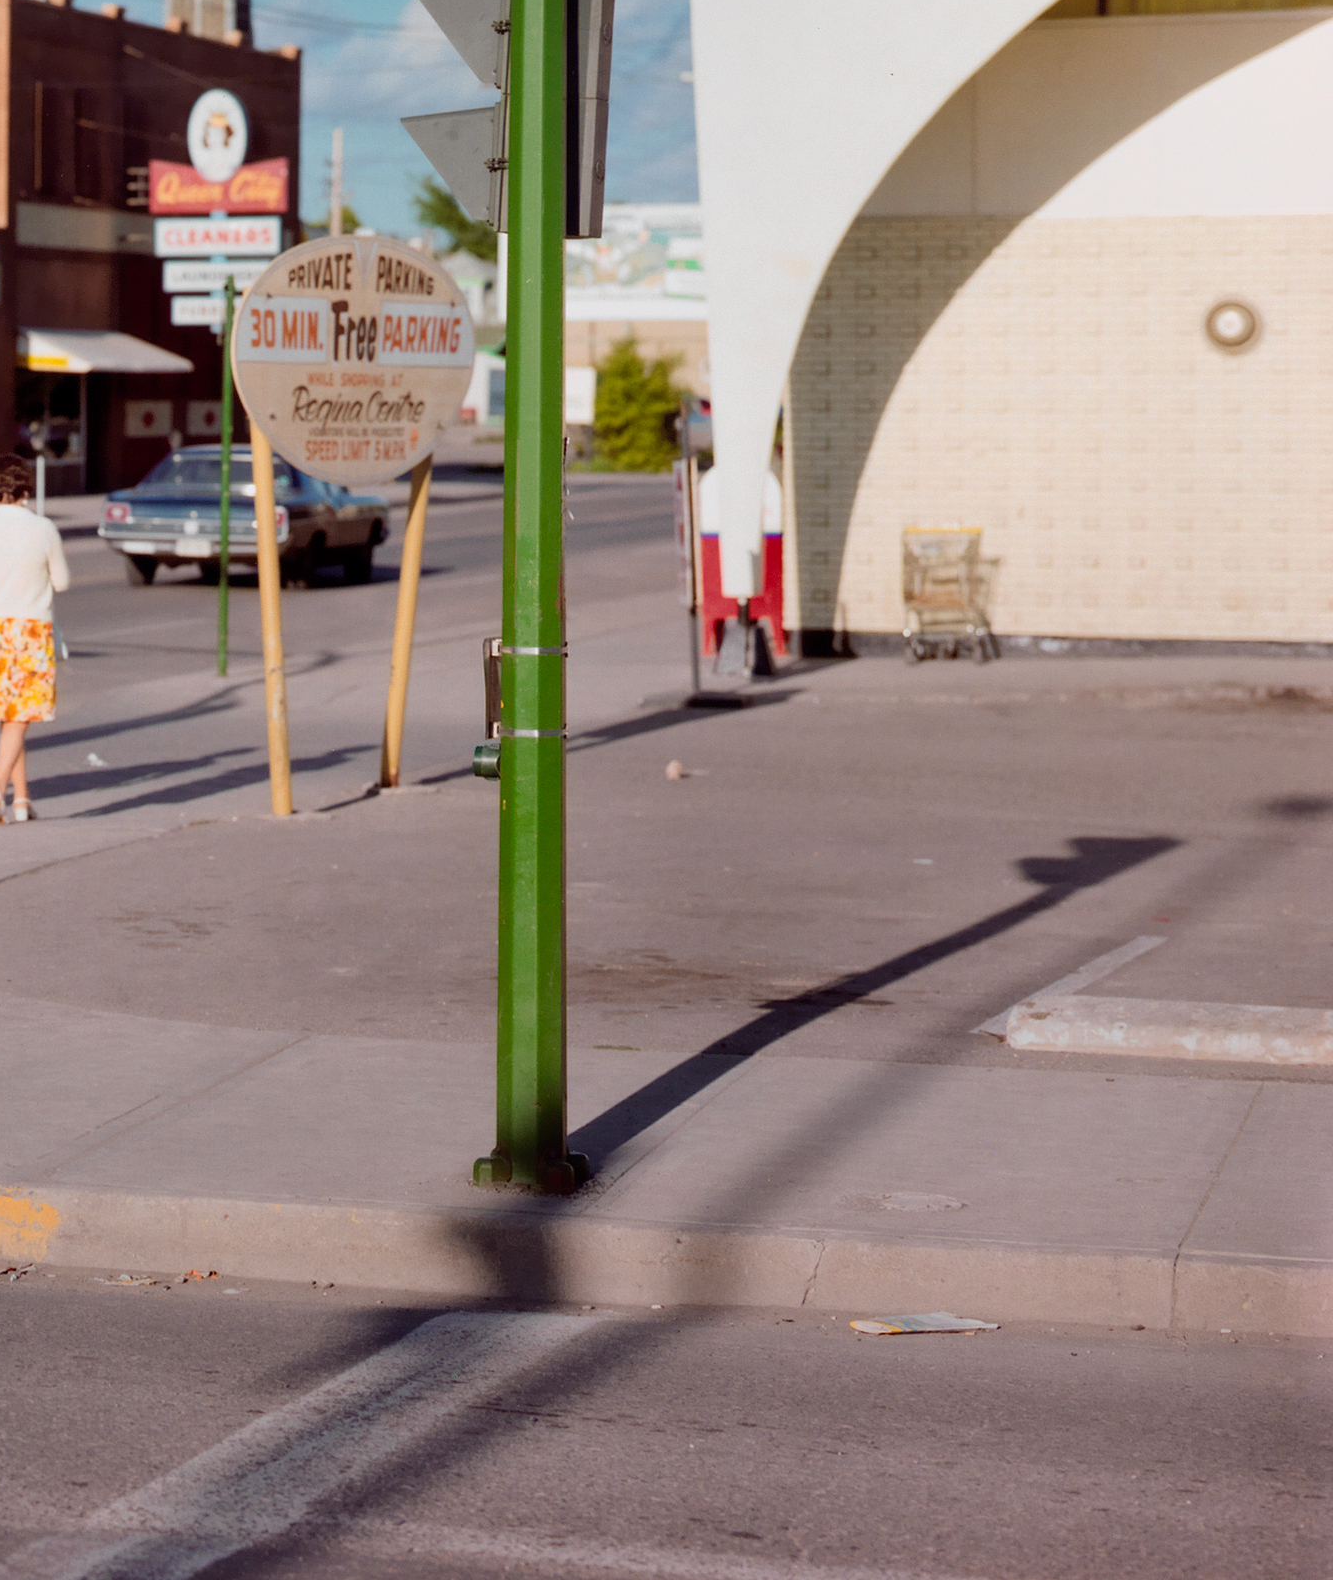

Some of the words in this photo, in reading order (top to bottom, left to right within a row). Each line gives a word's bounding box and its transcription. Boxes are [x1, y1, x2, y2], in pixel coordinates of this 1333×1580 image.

[288, 253, 352, 290] PRIVATE
[376, 256, 434, 296] PARKING
[250, 308, 276, 348] 30
[282, 311, 324, 350] MIN.
[331, 300, 377, 362] Free
[382, 315, 462, 354] PARKING
[292, 385, 363, 433] Regina
[365, 390, 426, 423] Centre
[305, 440, 339, 462] SPEED
[341, 440, 371, 462] LIMIT
